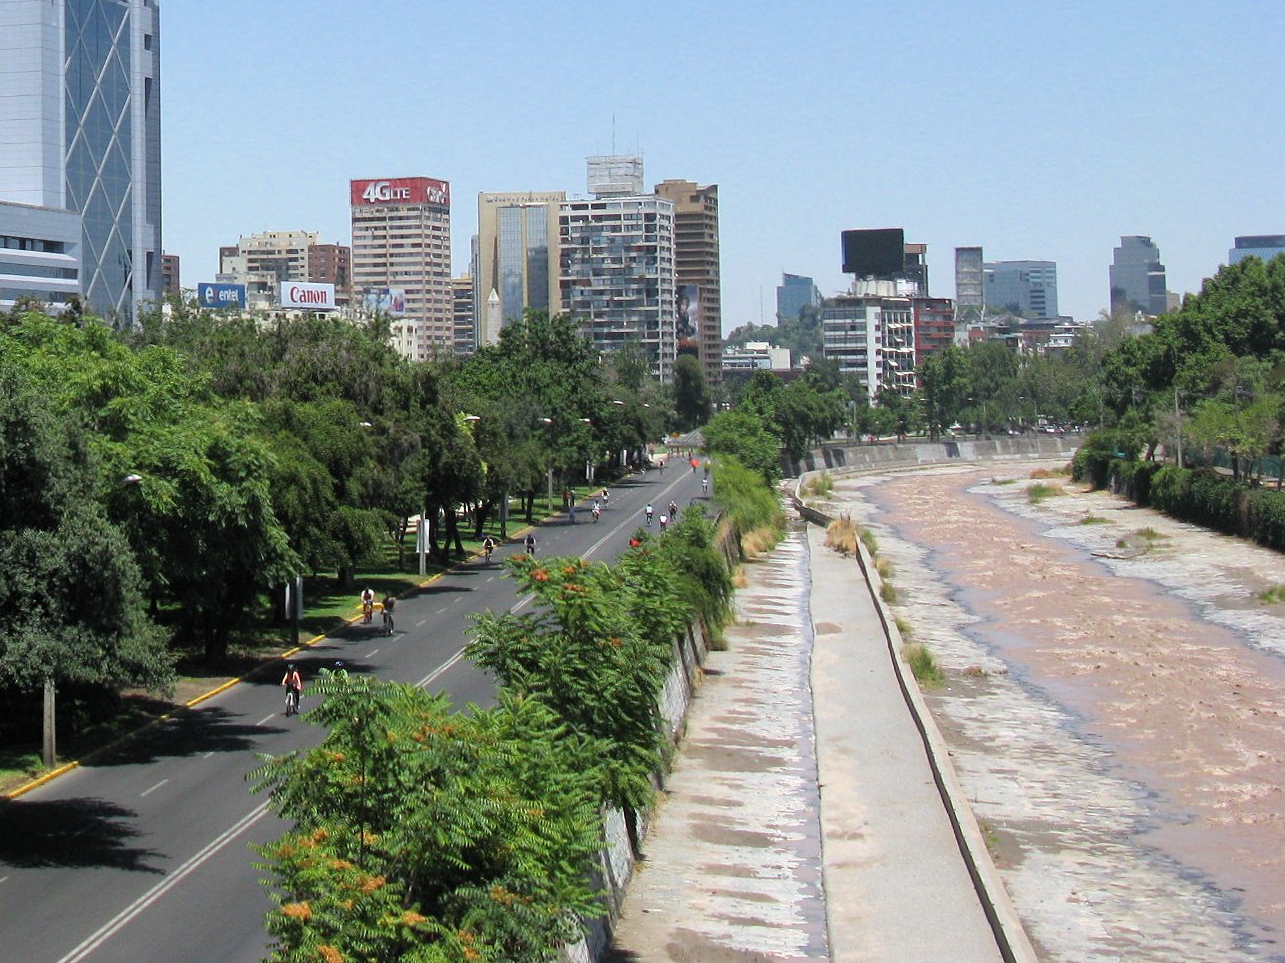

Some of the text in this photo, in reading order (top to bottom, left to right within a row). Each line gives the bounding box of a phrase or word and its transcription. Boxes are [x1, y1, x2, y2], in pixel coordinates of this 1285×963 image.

[363, 181, 389, 202] 4G
[390, 187, 410, 199] LTE
[218, 288, 239, 302] entel
[290, 286, 327, 304] Canon
